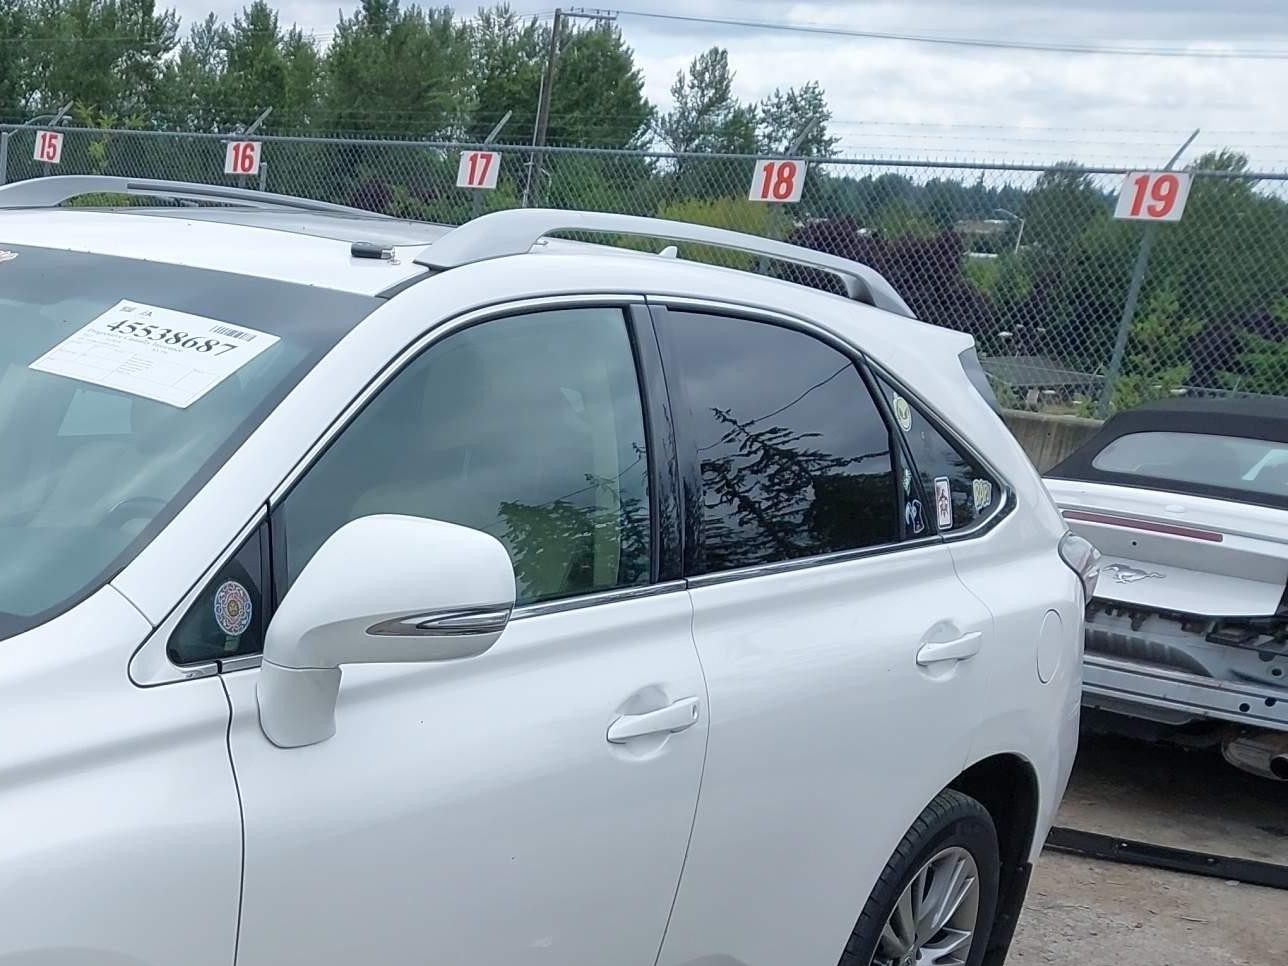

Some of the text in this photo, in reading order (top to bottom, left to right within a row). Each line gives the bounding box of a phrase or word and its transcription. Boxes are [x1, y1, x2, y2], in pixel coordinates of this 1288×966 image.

[39, 133, 59, 161] 15
[232, 142, 256, 173] 16
[467, 153, 493, 186] 17
[760, 161, 797, 200] 18
[1130, 173, 1180, 218] 19
[106, 319, 240, 357] 45538687
